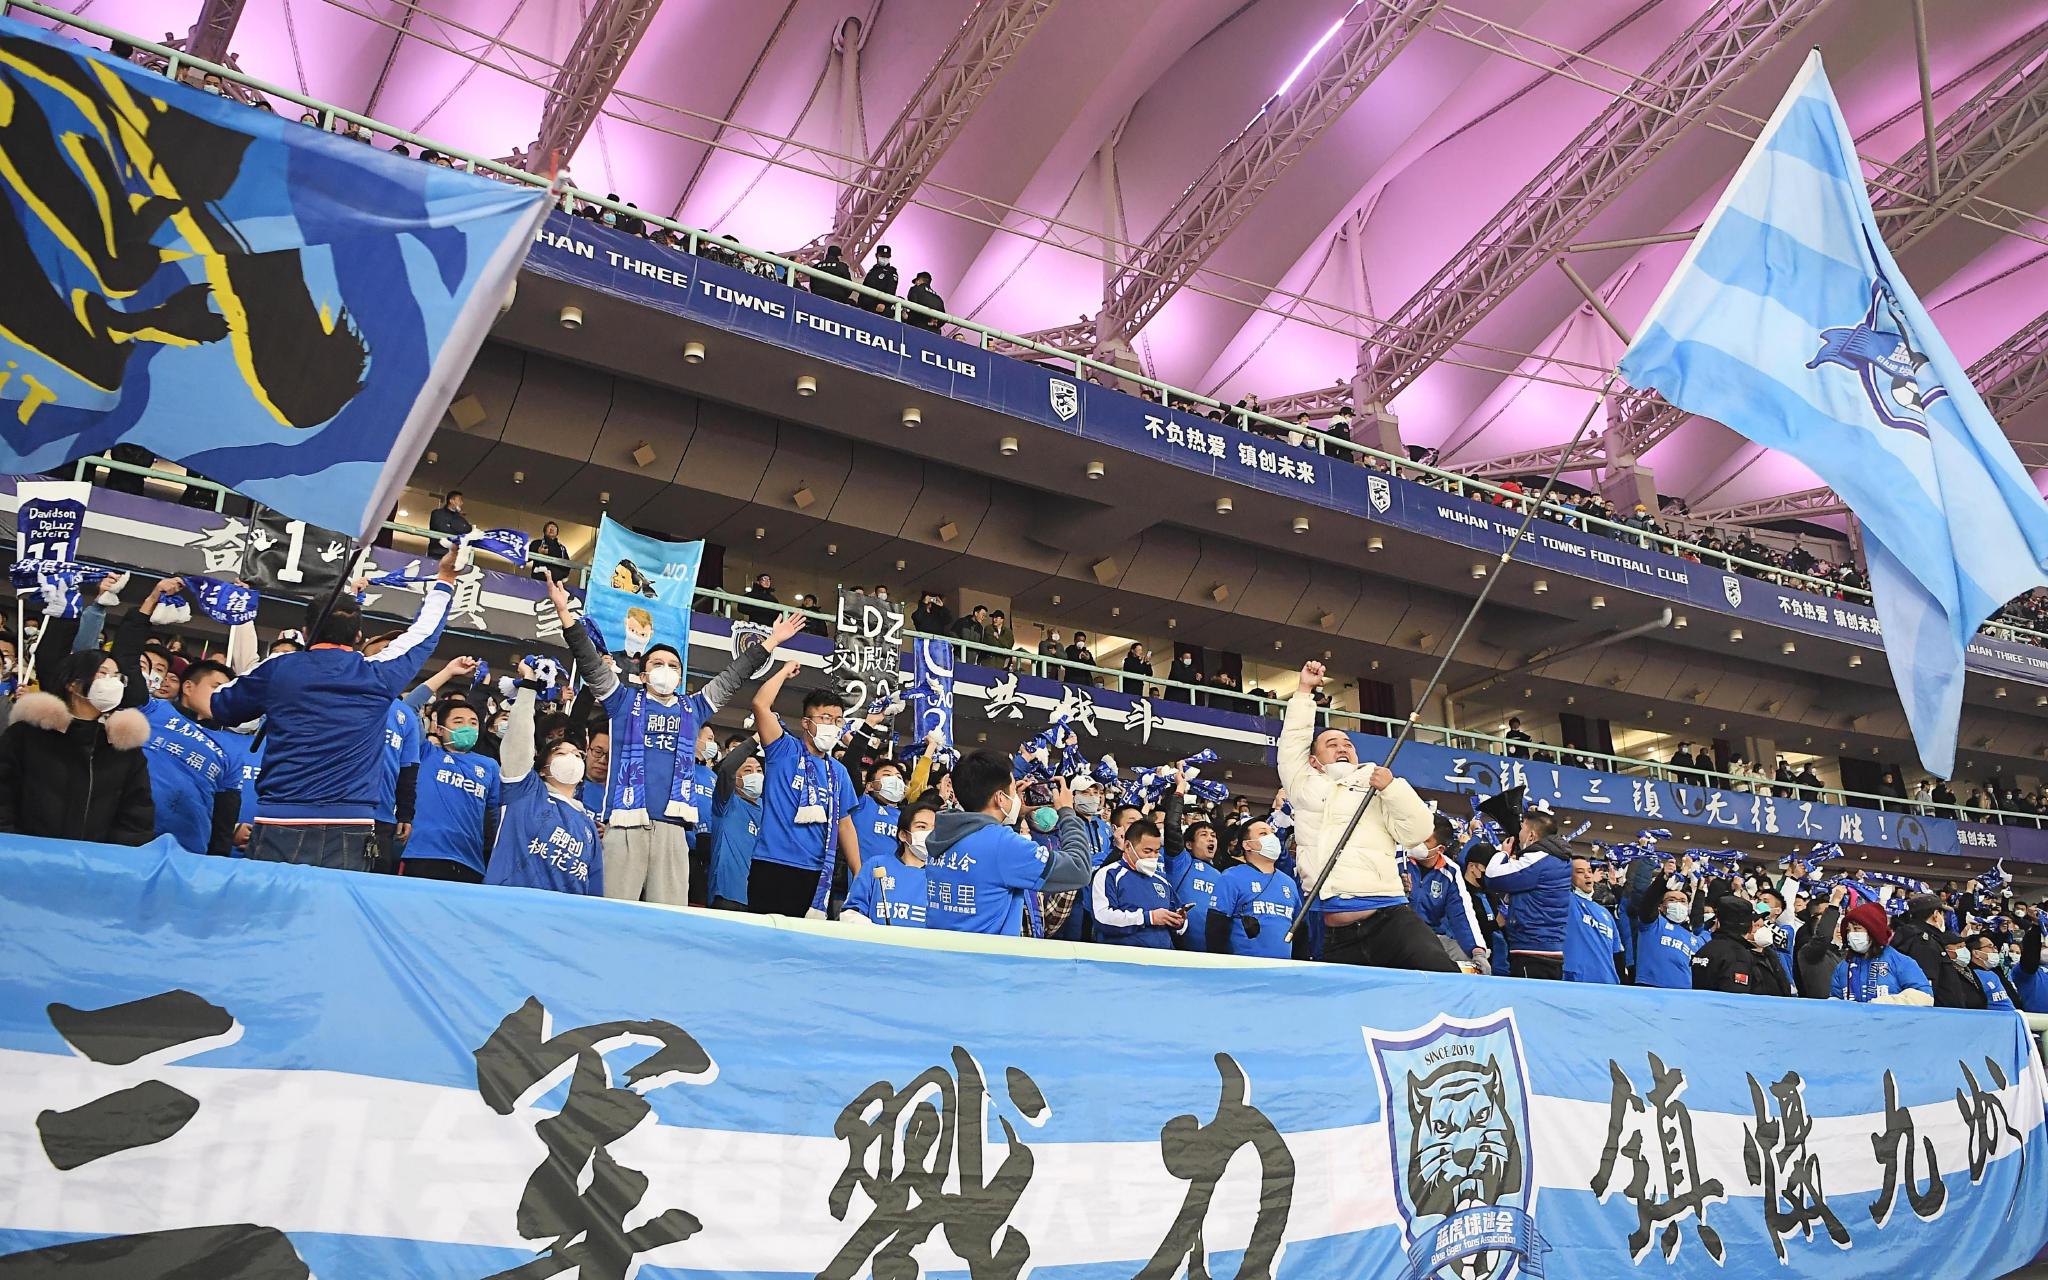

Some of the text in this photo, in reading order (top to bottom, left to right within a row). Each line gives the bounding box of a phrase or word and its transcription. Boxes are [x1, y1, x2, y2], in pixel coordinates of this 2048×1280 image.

[606, 250, 688, 289] THREE
[699, 280, 785, 320] TOWNS
[796, 310, 912, 358] FOOTBALL
[921, 350, 976, 378] CLUB
[1144, 414, 1315, 484] 不负热爱 镇创未来
[29, 507, 77, 519] Davidson
[31, 529, 70, 539] Pereira
[1437, 505, 1488, 530] WUHAN
[1540, 535, 1586, 558] TOWNS
[1590, 549, 1653, 576] FOOTBALL
[1657, 567, 1688, 584] CLUB
[26, 541, 68, 563] 11
[277, 520, 306, 583] 1
[837, 596, 904, 645] LDZ
[1777, 595, 1882, 636] 不负热爱 镇创未来
[833, 644, 899, 678] 刘殿座
[1994, 650, 2025, 664] THREE
[647, 714, 680, 732] 融创
[436, 769, 487, 799] 武汉三镇
[548, 826, 583, 856] 融创
[1957, 829, 1998, 848] 镇创未来
[527, 837, 589, 882] 桃花源
[1424, 1044, 1475, 1066] SINCE 2019
[1435, 1211, 1514, 1252] 蓝虎球迷会
[1431, 1251, 1446, 1266] Blue
